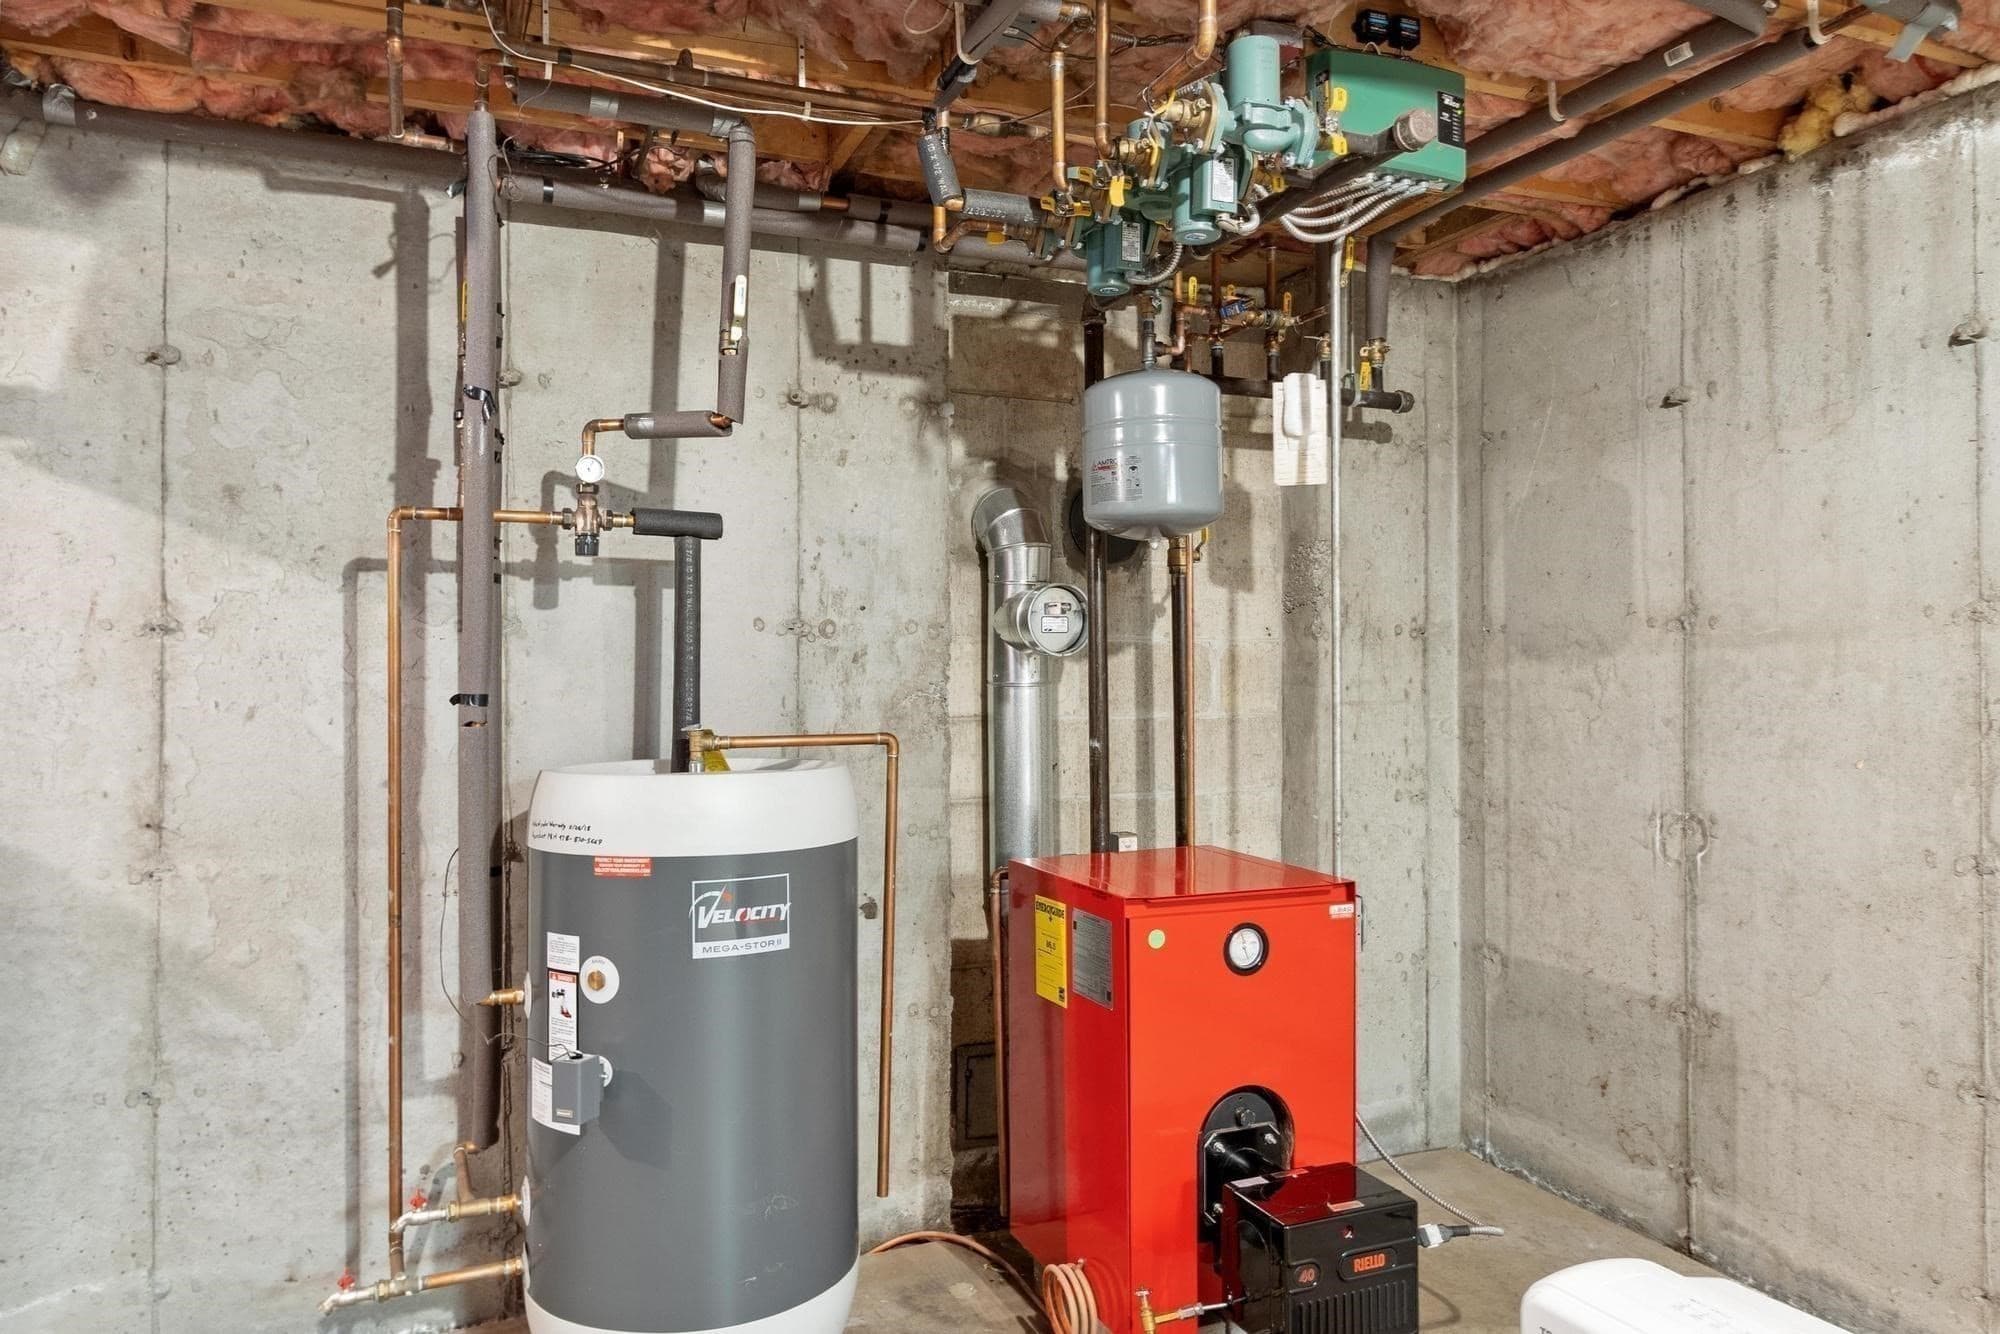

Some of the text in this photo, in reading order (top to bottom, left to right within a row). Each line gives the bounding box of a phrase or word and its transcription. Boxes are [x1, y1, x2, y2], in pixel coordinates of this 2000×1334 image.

[698, 886, 791, 928] VELOCITY
[702, 940, 775, 953] MEGA-STOR
[1353, 1254, 1385, 1273] RIELLO
[1299, 1268, 1315, 1283] 40
